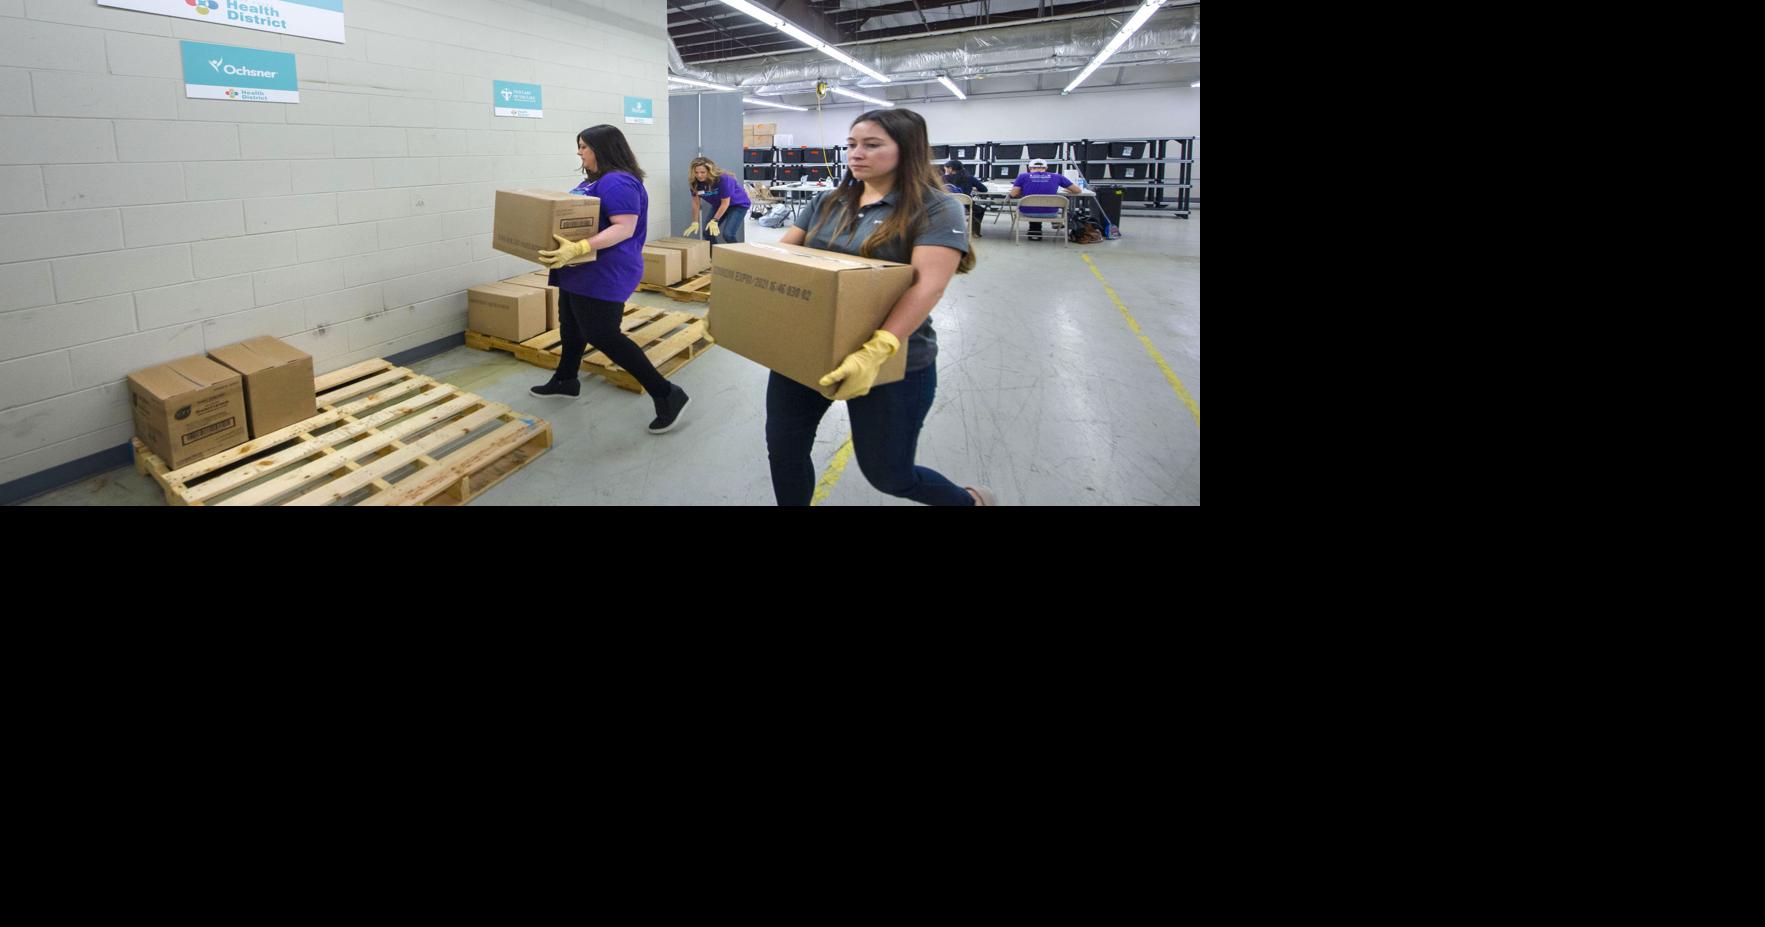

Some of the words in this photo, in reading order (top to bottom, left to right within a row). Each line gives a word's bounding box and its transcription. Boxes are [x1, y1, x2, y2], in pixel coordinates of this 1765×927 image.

[226, 0, 279, 17] Health
[227, 10, 287, 28] District
[223, 64, 276, 78] Ochsner
